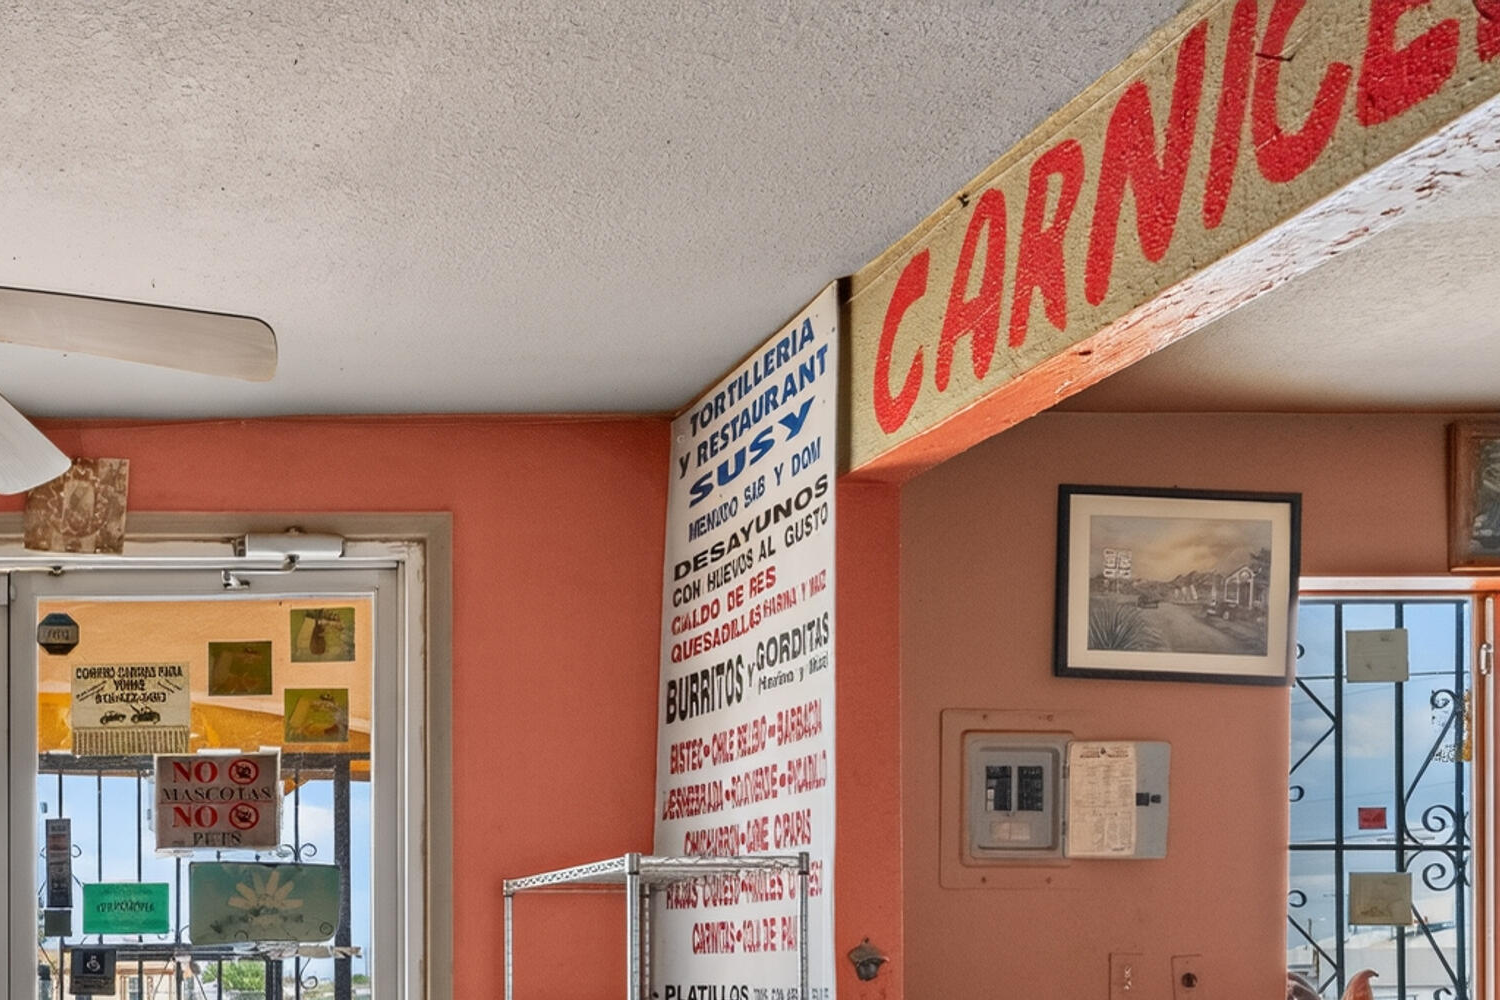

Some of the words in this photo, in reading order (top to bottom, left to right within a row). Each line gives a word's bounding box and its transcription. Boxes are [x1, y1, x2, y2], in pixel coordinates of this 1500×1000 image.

[874, 0, 1500, 434] CARNICE
[678, 448, 690, 479] Y
[696, 343, 829, 468] RESTAURANT
[690, 317, 815, 438] TORTILLERIA
[688, 396, 816, 508] SUSY
[672, 580, 701, 608] CON
[707, 548, 753, 593] HUEVOS
[758, 543, 776, 563] AL
[784, 502, 828, 549] GUSTO
[674, 473, 829, 582] DESAYUNOS
[666, 654, 745, 724] BURRITOS
[756, 612, 829, 671] GORDITAS
[161, 786, 273, 802] MASCOTAS
[172, 760, 219, 784] NO
[172, 804, 219, 829] NO
